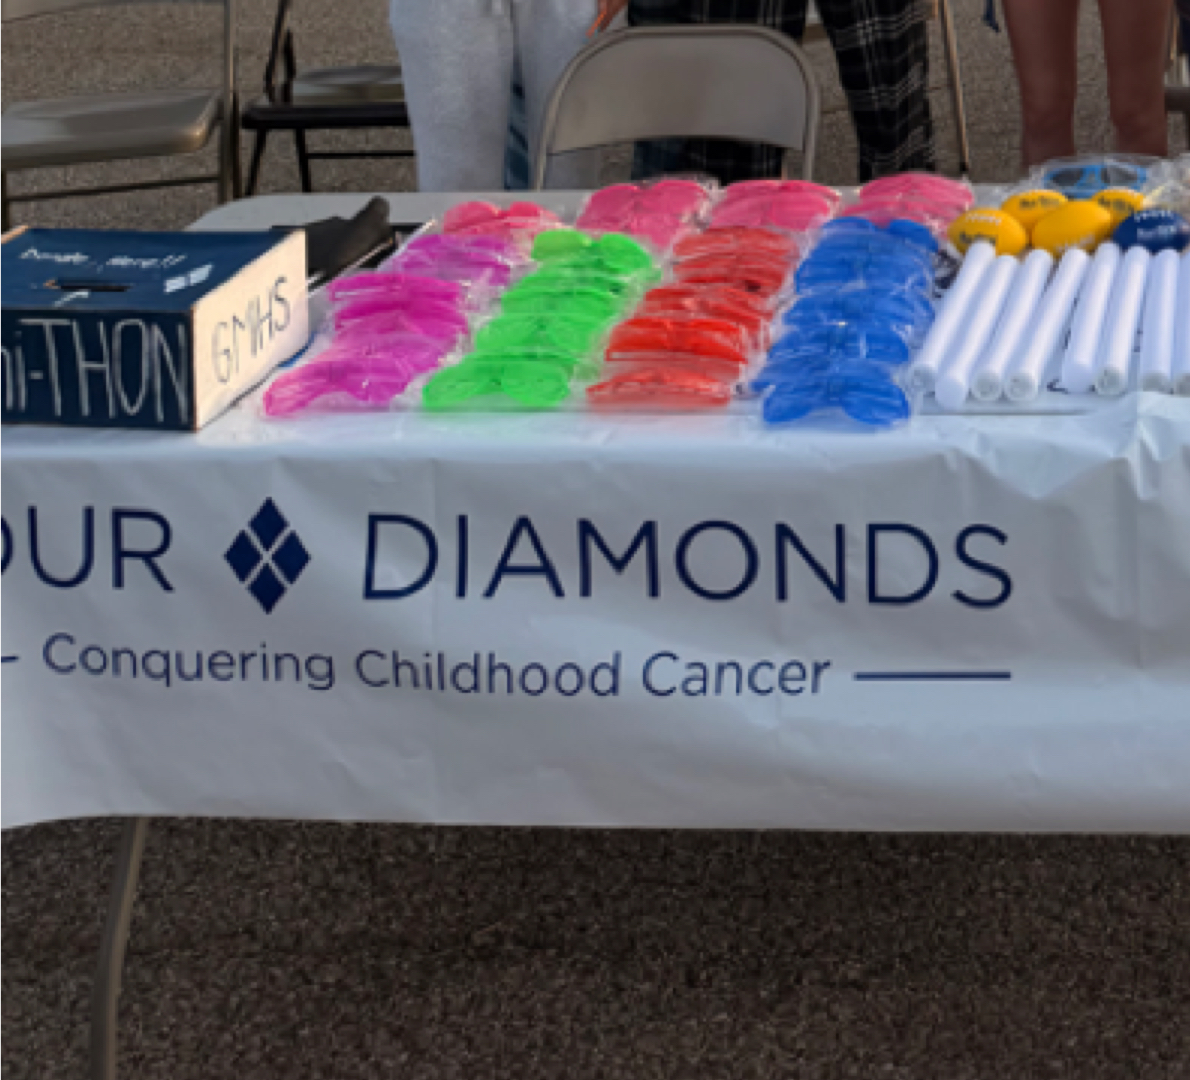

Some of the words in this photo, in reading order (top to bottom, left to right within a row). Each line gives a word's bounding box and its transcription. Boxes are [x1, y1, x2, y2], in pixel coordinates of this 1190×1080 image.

[210, 275, 291, 384] GMHS
[1, 504, 174, 592] UR
[362, 511, 1014, 611] DIAMONDS
[42, 632, 336, 691] Conquering
[354, 649, 622, 697] Childhood
[642, 650, 831, 697] Cancer
